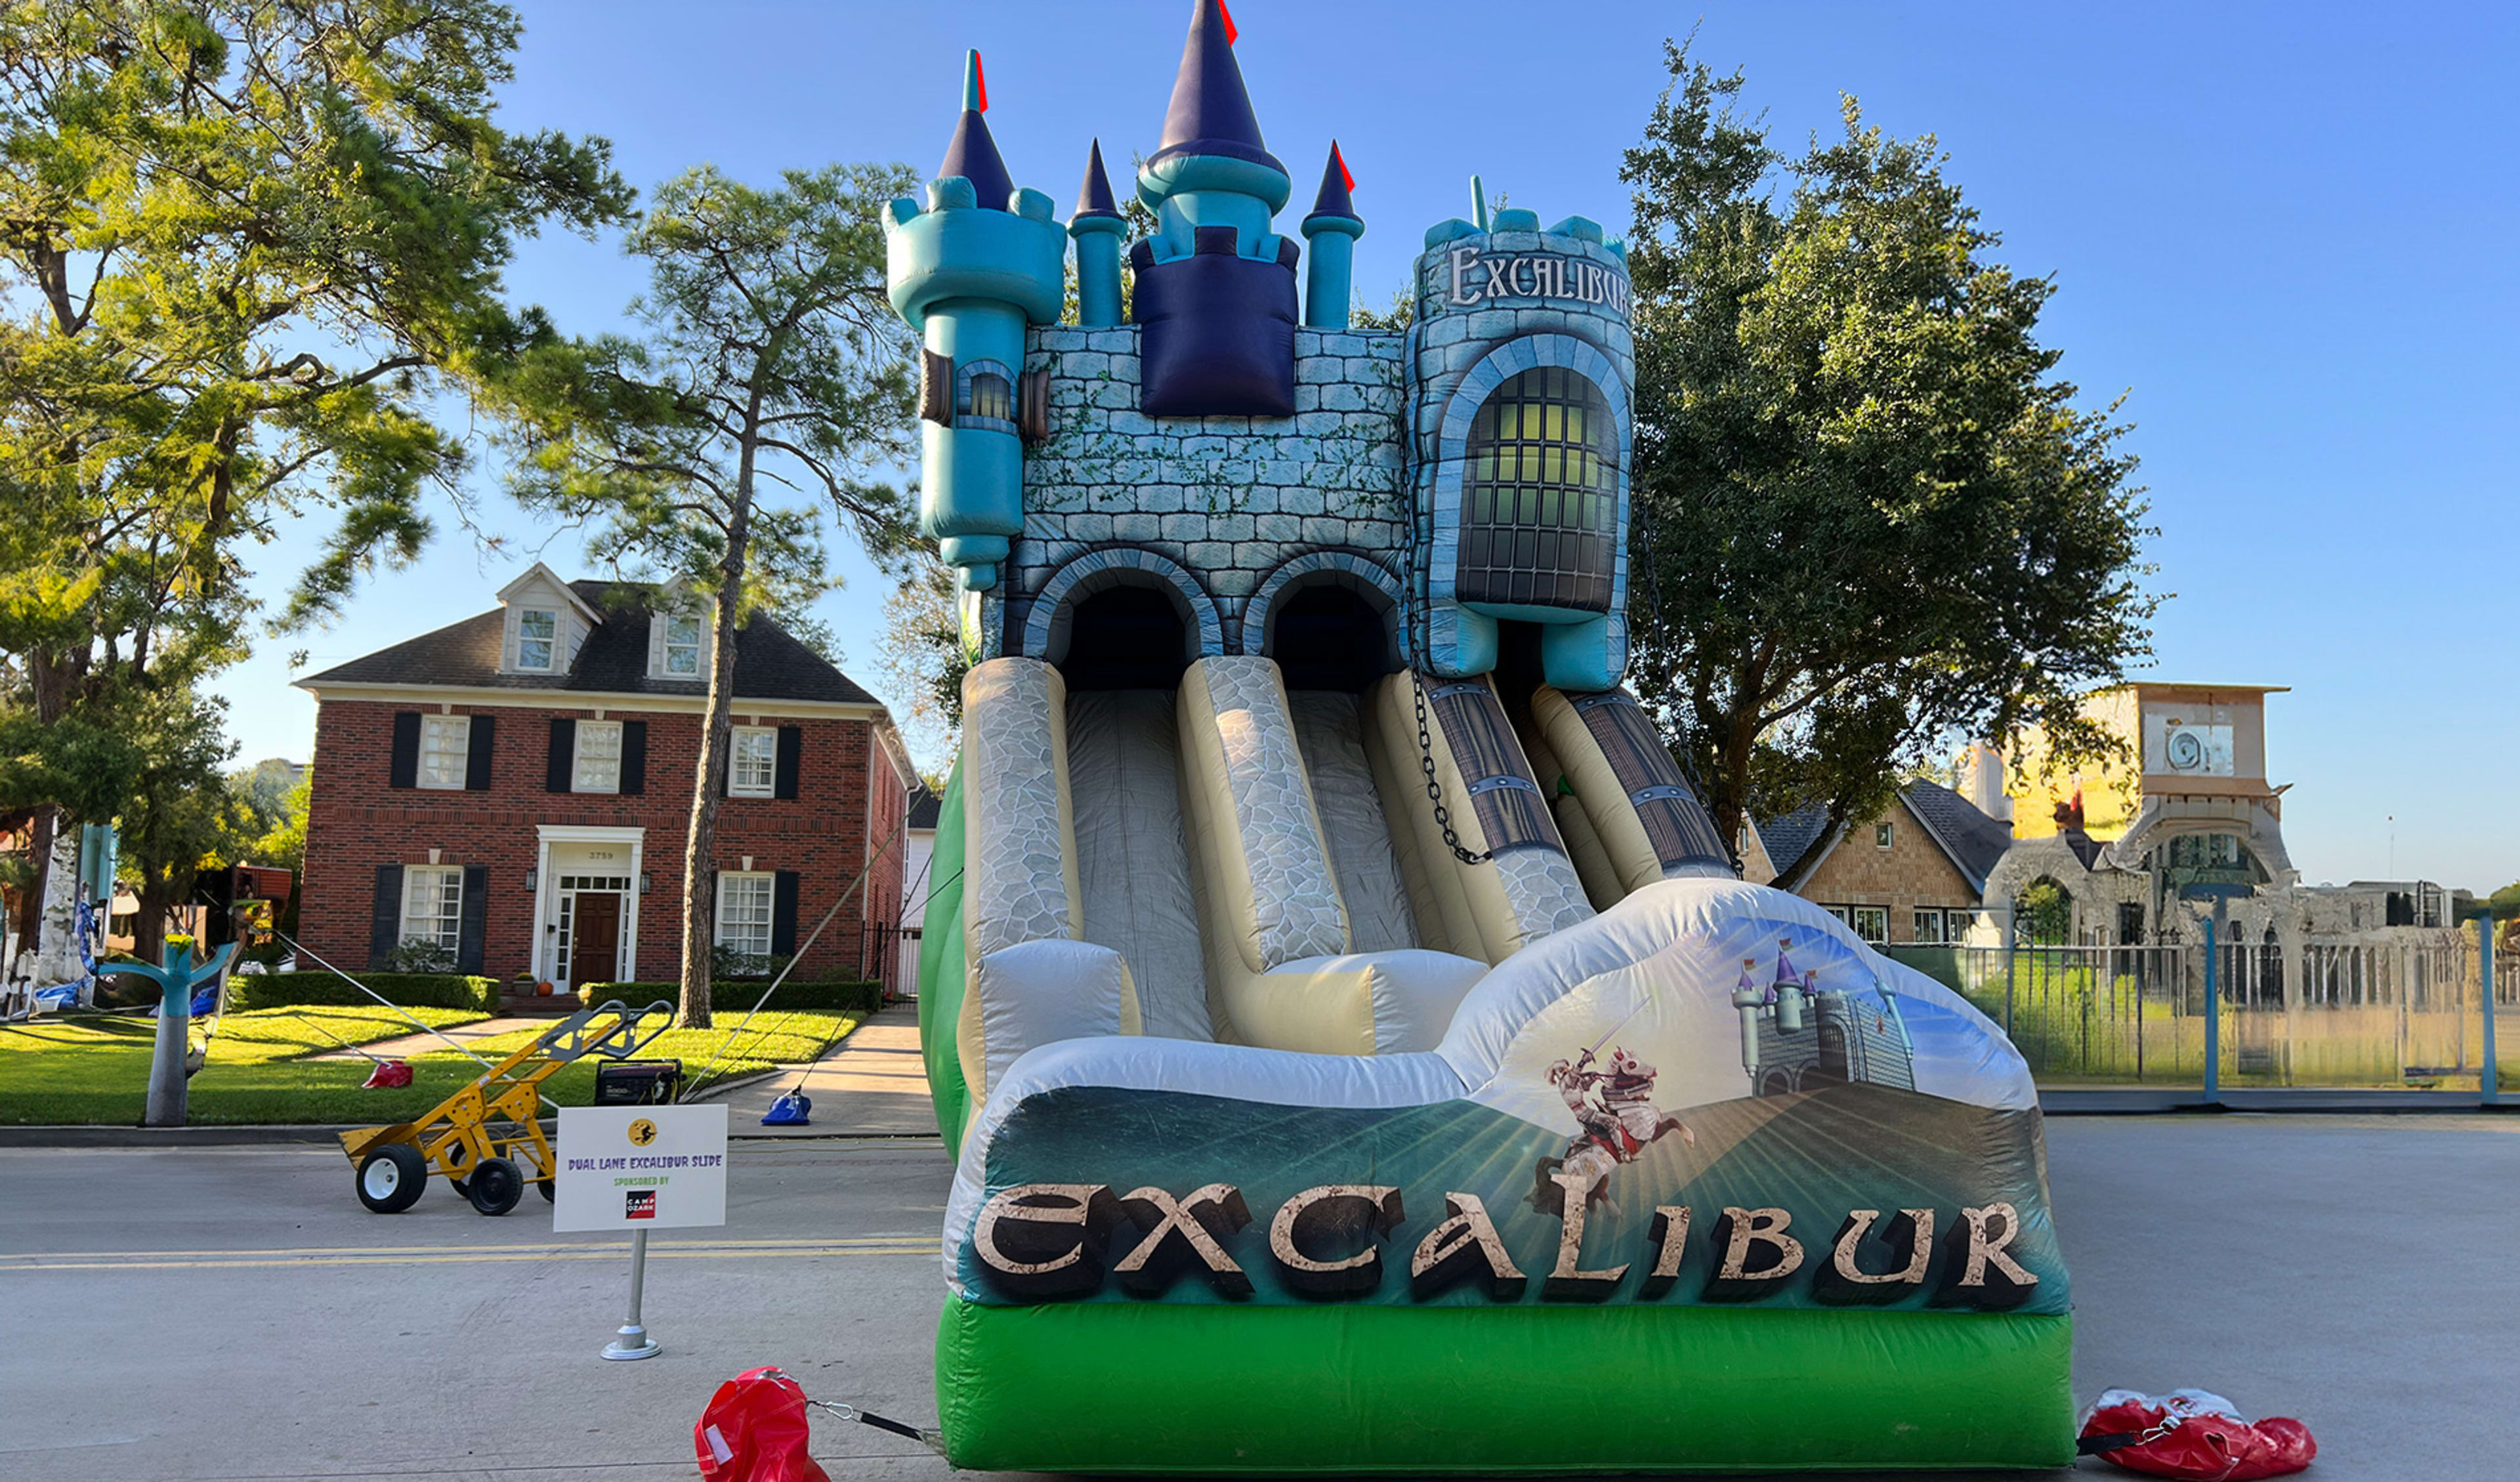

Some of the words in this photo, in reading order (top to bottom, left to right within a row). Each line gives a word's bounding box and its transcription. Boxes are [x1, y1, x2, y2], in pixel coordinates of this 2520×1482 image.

[1451, 247, 1628, 318] EXCALIBUR
[568, 1159, 596, 1170] DUAL
[599, 1158, 626, 1170] LANE
[630, 1156, 688, 1169] EXCALIBUR
[692, 1155, 722, 1167] SLIDE
[614, 1177, 657, 1186] SPONSORED
[660, 1176, 669, 1185] BY
[974, 1174, 2039, 1287] EXCALIBUR
